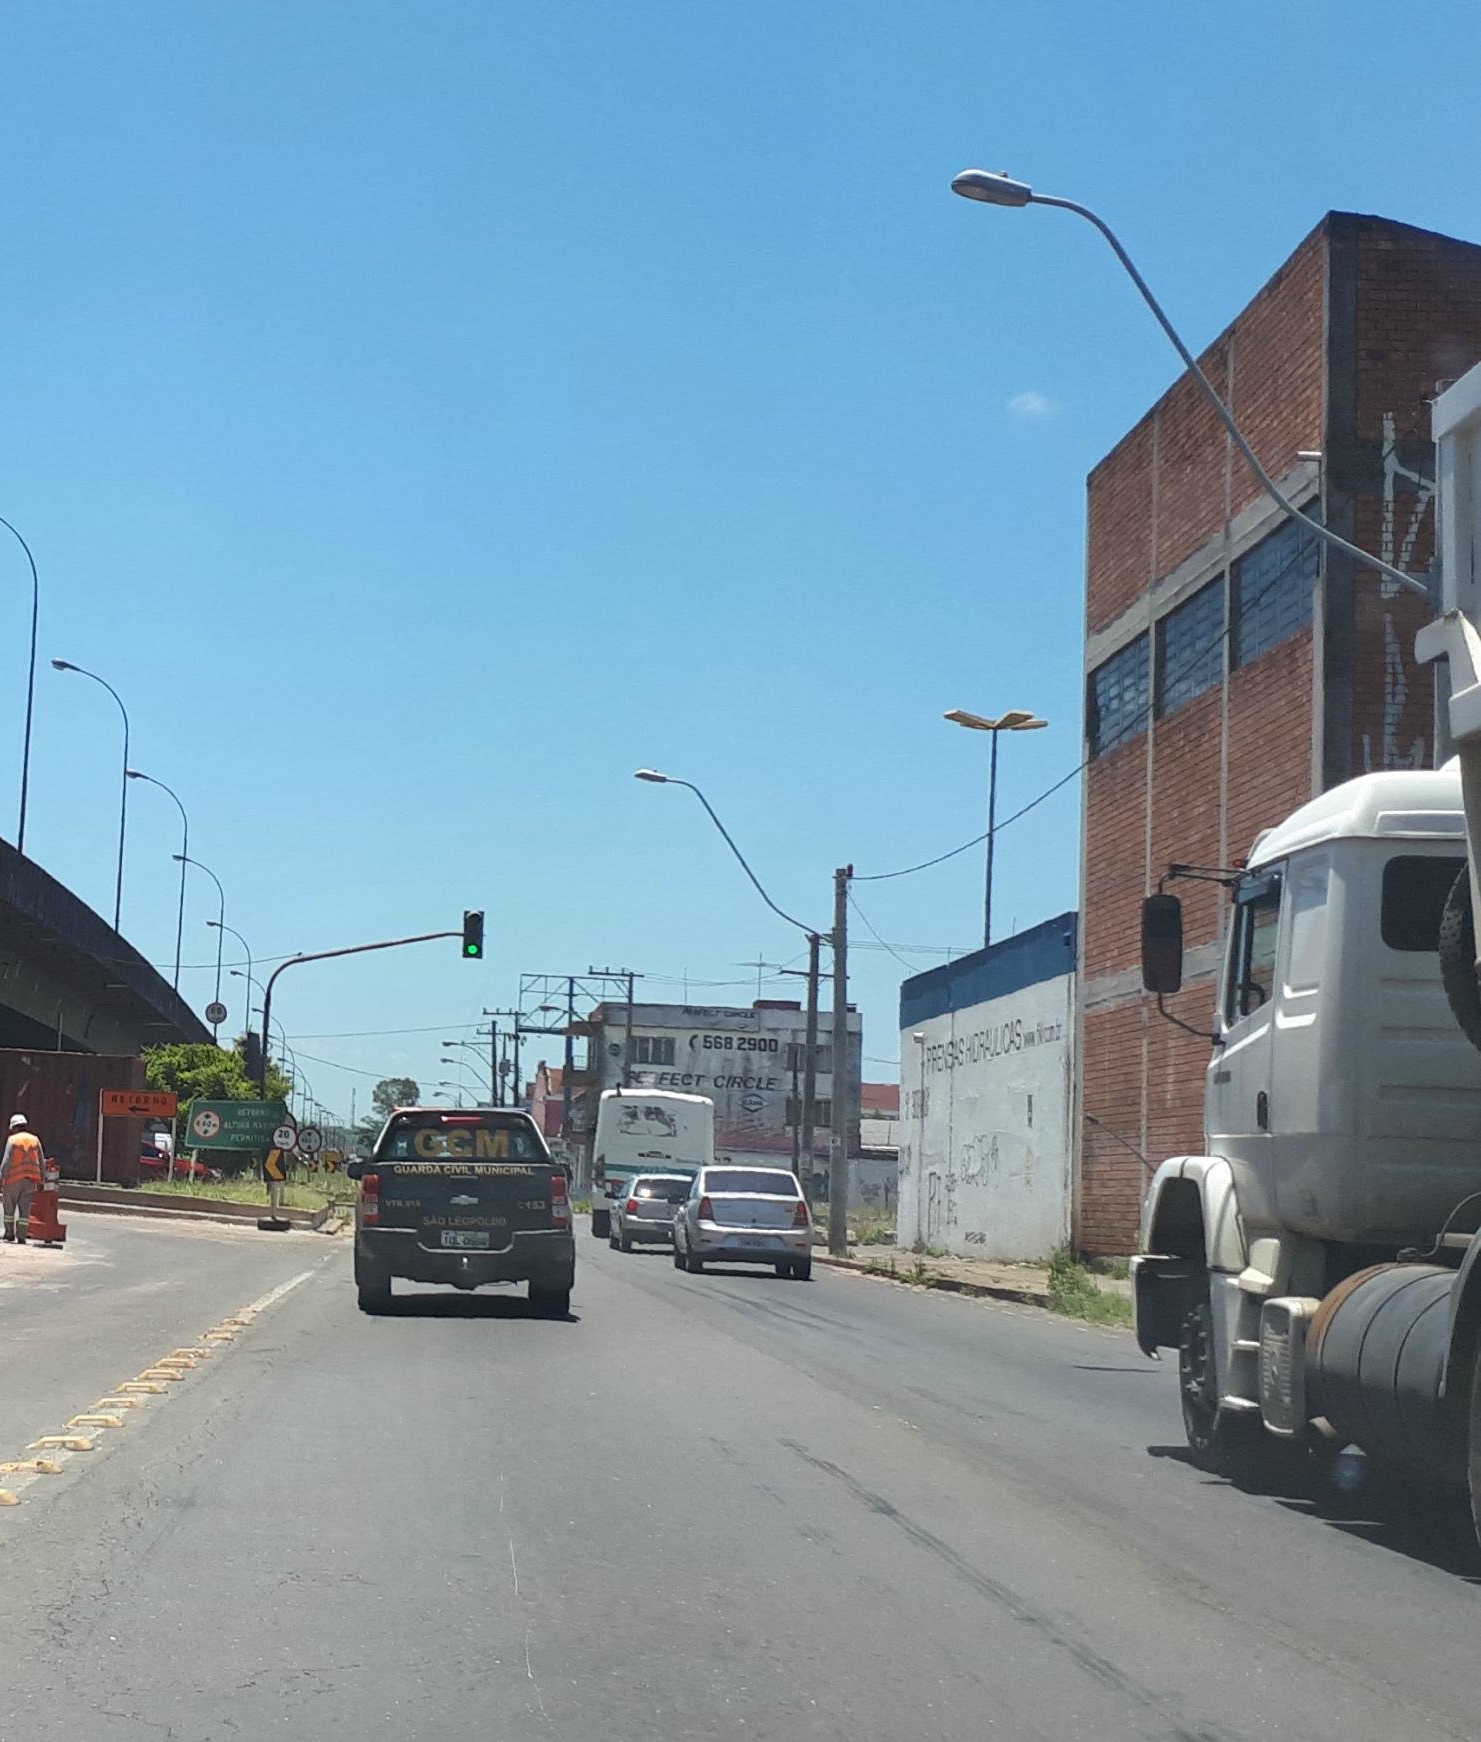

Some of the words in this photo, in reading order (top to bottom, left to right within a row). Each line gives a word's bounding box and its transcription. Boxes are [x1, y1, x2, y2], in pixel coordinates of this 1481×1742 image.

[723, 1011, 755, 1019] CIRCLE
[702, 1035, 733, 1050] 568
[737, 1038, 779, 1052] 2900
[713, 1075, 778, 1091] CIRCLE
[111, 1094, 168, 1105] RETORNO
[278, 1129, 290, 1139] 20
[414, 1129, 510, 1158] GCM
[394, 1165, 441, 1175] GUARDA
[443, 1166, 472, 1175] CIVIL
[474, 1166, 535, 1176] MUNICIPAL
[448, 1216, 507, 1227] LEOPOLDO
